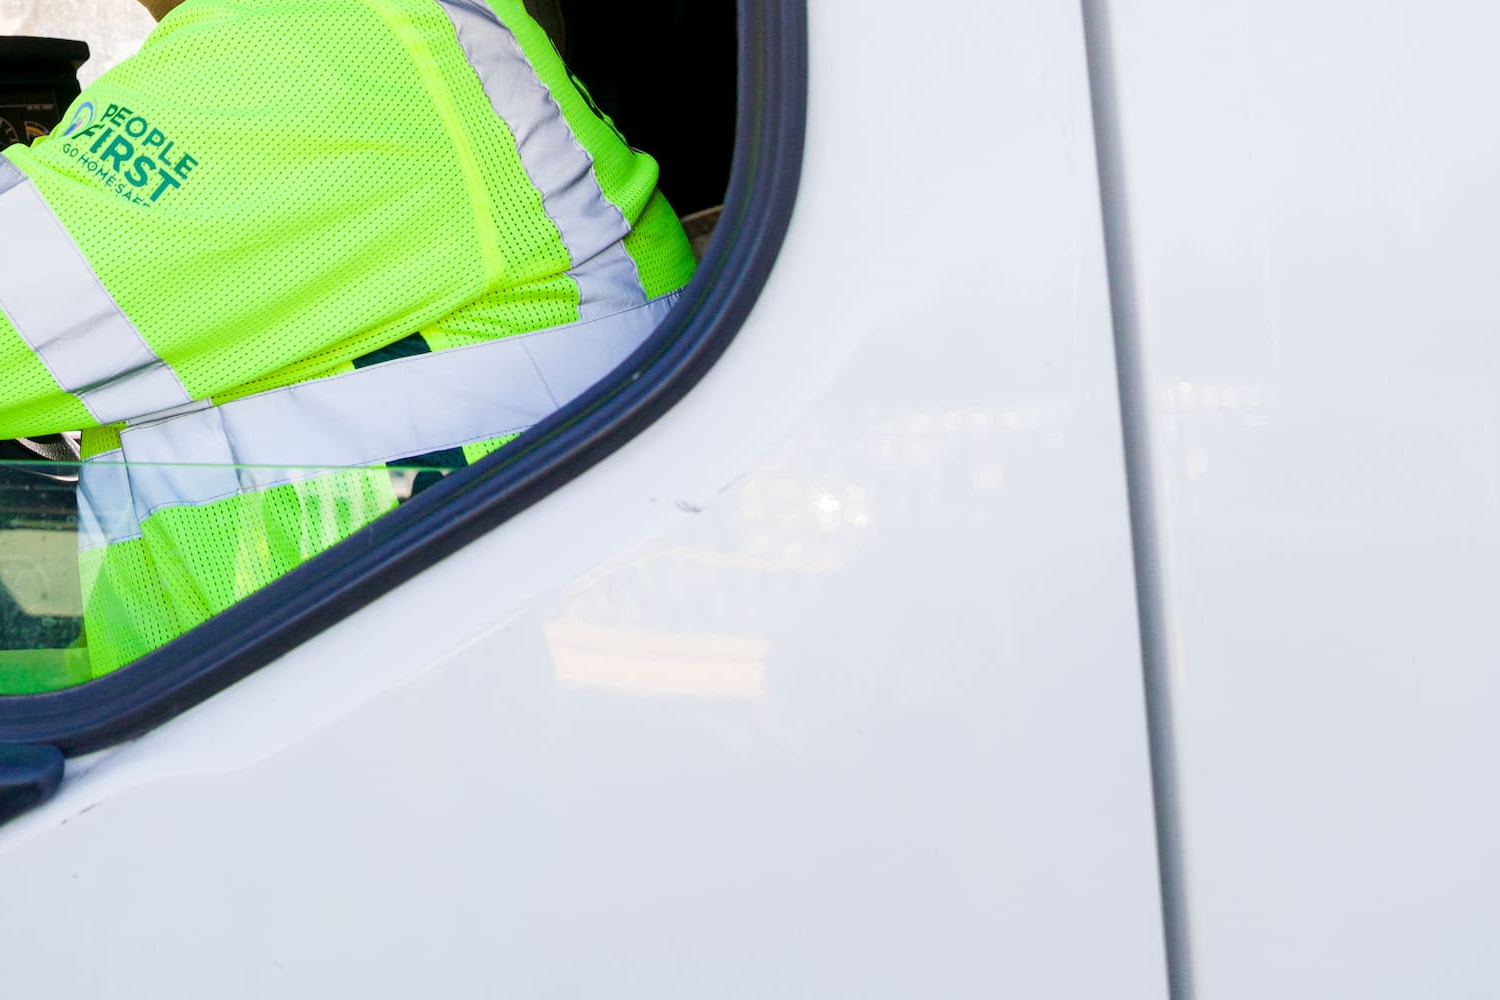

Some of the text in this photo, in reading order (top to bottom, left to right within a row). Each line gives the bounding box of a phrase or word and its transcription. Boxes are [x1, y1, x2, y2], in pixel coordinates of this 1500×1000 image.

[62, 143, 79, 158] GO
[79, 155, 116, 187] HOME
[72, 124, 181, 202] FIRST
[101, 103, 199, 180] PEOPLE
